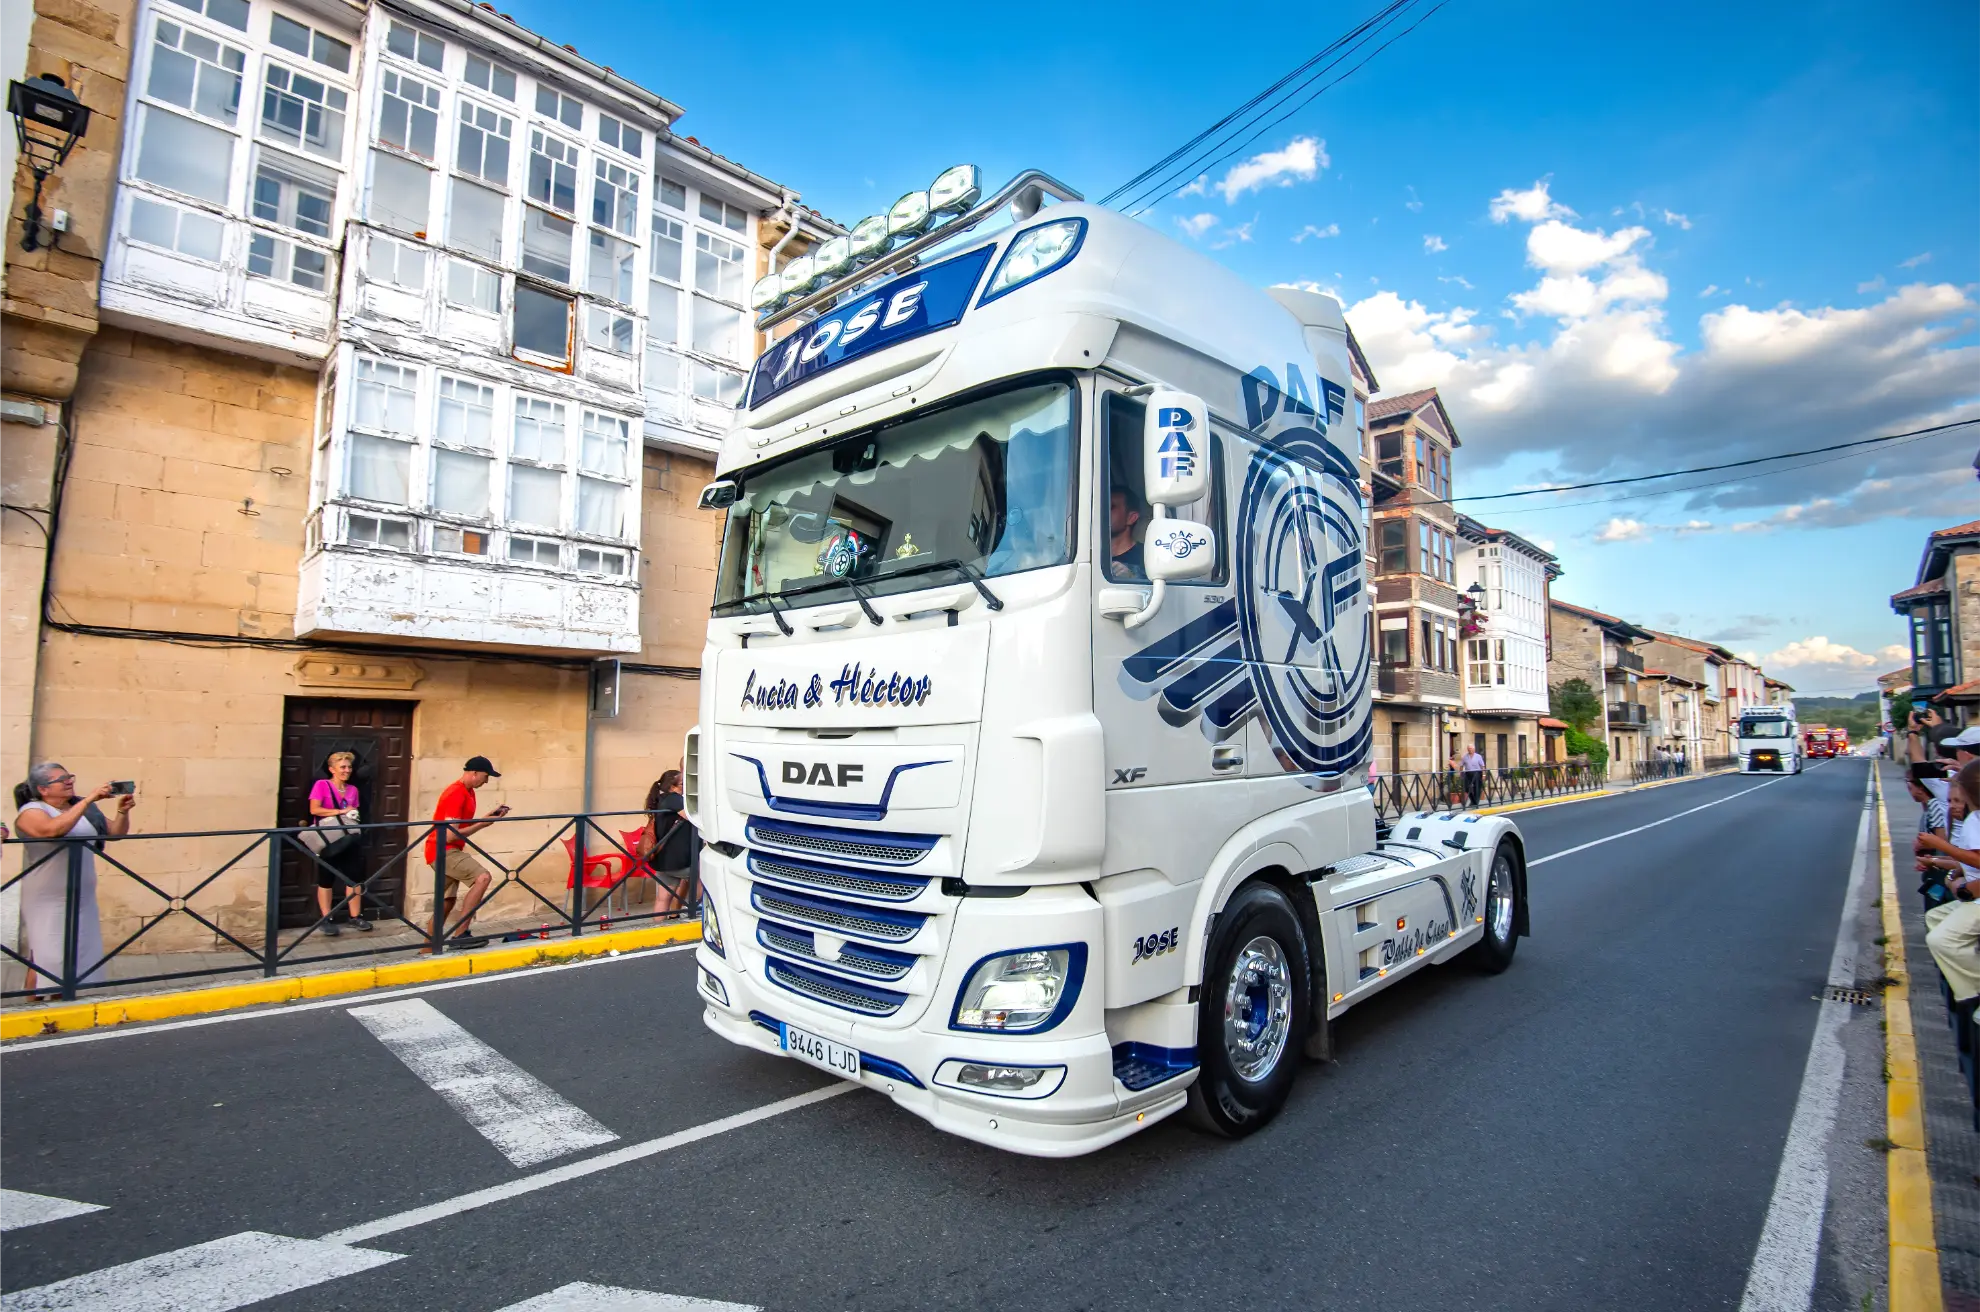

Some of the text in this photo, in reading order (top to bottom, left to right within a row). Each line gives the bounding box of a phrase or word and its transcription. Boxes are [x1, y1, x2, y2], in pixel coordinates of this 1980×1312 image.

[774, 281, 929, 386] JOSE
[1241, 362, 1346, 431] DAF
[1157, 406, 1197, 481] DAF
[1170, 531, 1193, 540] DAF
[1204, 594, 1225, 604] 530
[803, 673, 823, 709] &
[830, 661, 932, 708] Héctor
[782, 760, 864, 788] DAF
[1112, 767, 1148, 784] XF
[1132, 926, 1179, 966] JOSE
[789, 1030, 857, 1074] 9446 LJD
